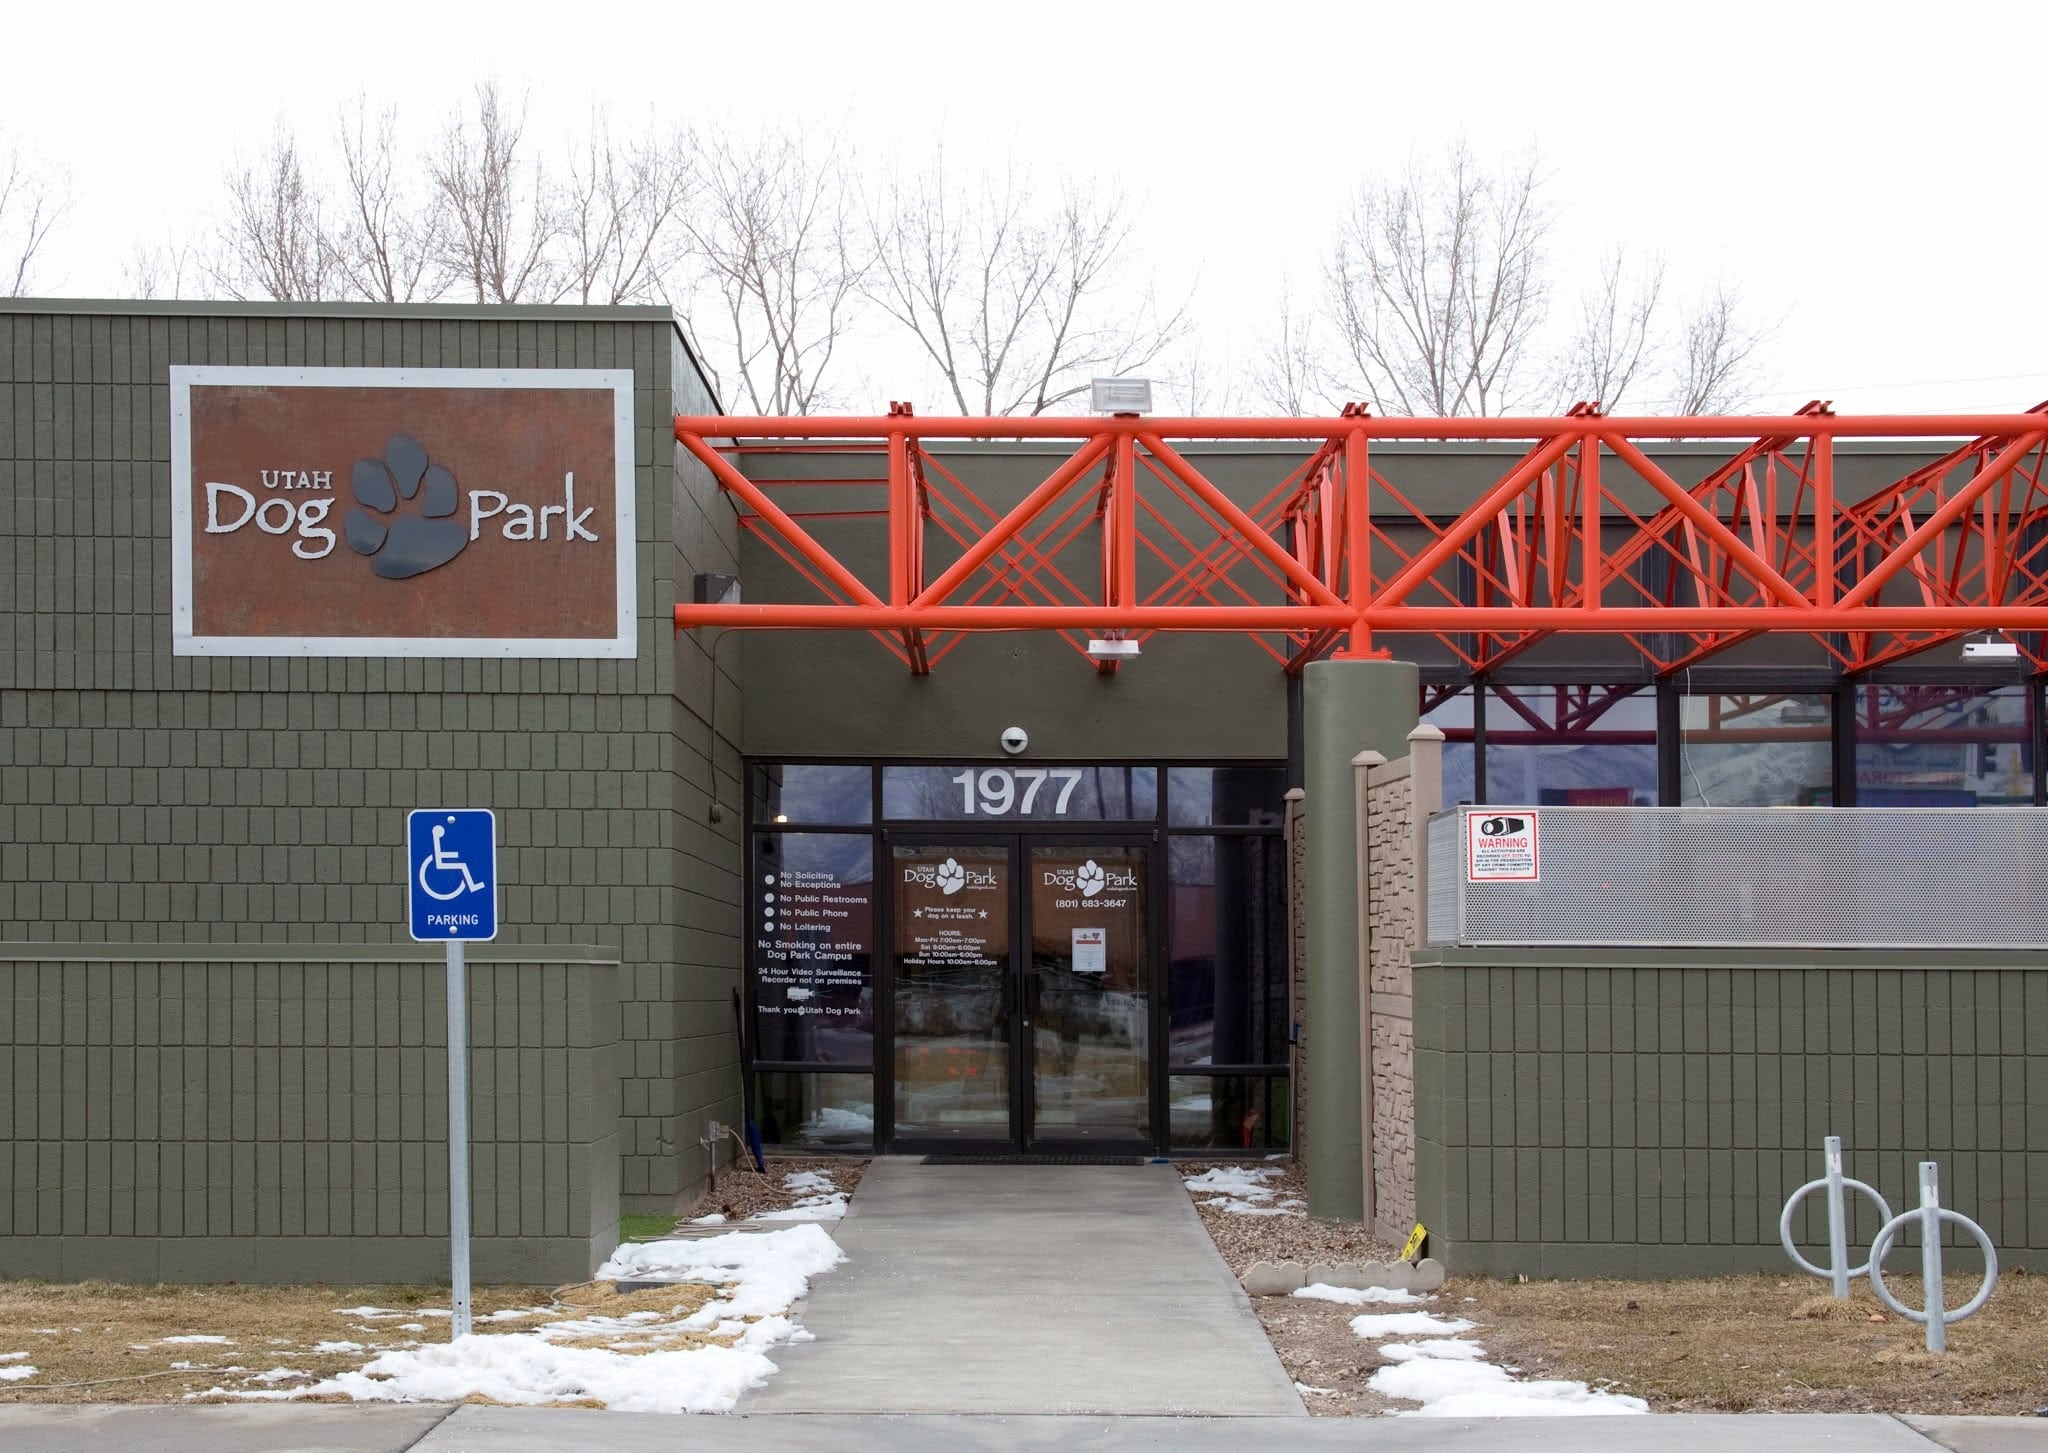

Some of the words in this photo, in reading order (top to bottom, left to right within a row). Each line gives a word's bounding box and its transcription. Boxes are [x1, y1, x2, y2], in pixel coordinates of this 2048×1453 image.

[260, 470, 333, 490] UTAH
[204, 482, 337, 560] Dog
[468, 472, 599, 542] Park
[952, 768, 1082, 815] 1977
[1478, 837, 1528, 848] WARNING
[795, 872, 834, 881] Soliciting
[904, 869, 936, 889] Dog
[966, 867, 998, 885] Park
[1043, 872, 1076, 891] Dog
[1106, 868, 1138, 886] Park
[795, 881, 841, 889] Exceptions
[795, 895, 820, 903] Public
[823, 895, 868, 904] Restrooms
[1055, 900, 1079, 908] (801)
[1081, 900, 1127, 908] 683-3647
[795, 909, 820, 917] Public
[822, 910, 849, 918] Phone
[427, 914, 479, 926] PARKING
[795, 923, 831, 932] Loitering
[758, 940, 772, 948] No
[775, 940, 816, 951] Smoking
[835, 942, 862, 951] entire
[767, 950, 787, 961] Dog
[790, 951, 811, 959] Park
[814, 951, 852, 961] Campus
[758, 967, 769, 975] 24
[770, 968, 789, 976] Hour
[791, 968, 813, 976] Video
[815, 968, 862, 977] Surveillance
[827, 978, 862, 986] premises
[758, 1005, 781, 1013] Thank
[783, 1007, 798, 1015] you
[805, 1006, 824, 1014] Utah
[825, 1007, 842, 1016] Dog
[844, 1007, 861, 1015] Park
